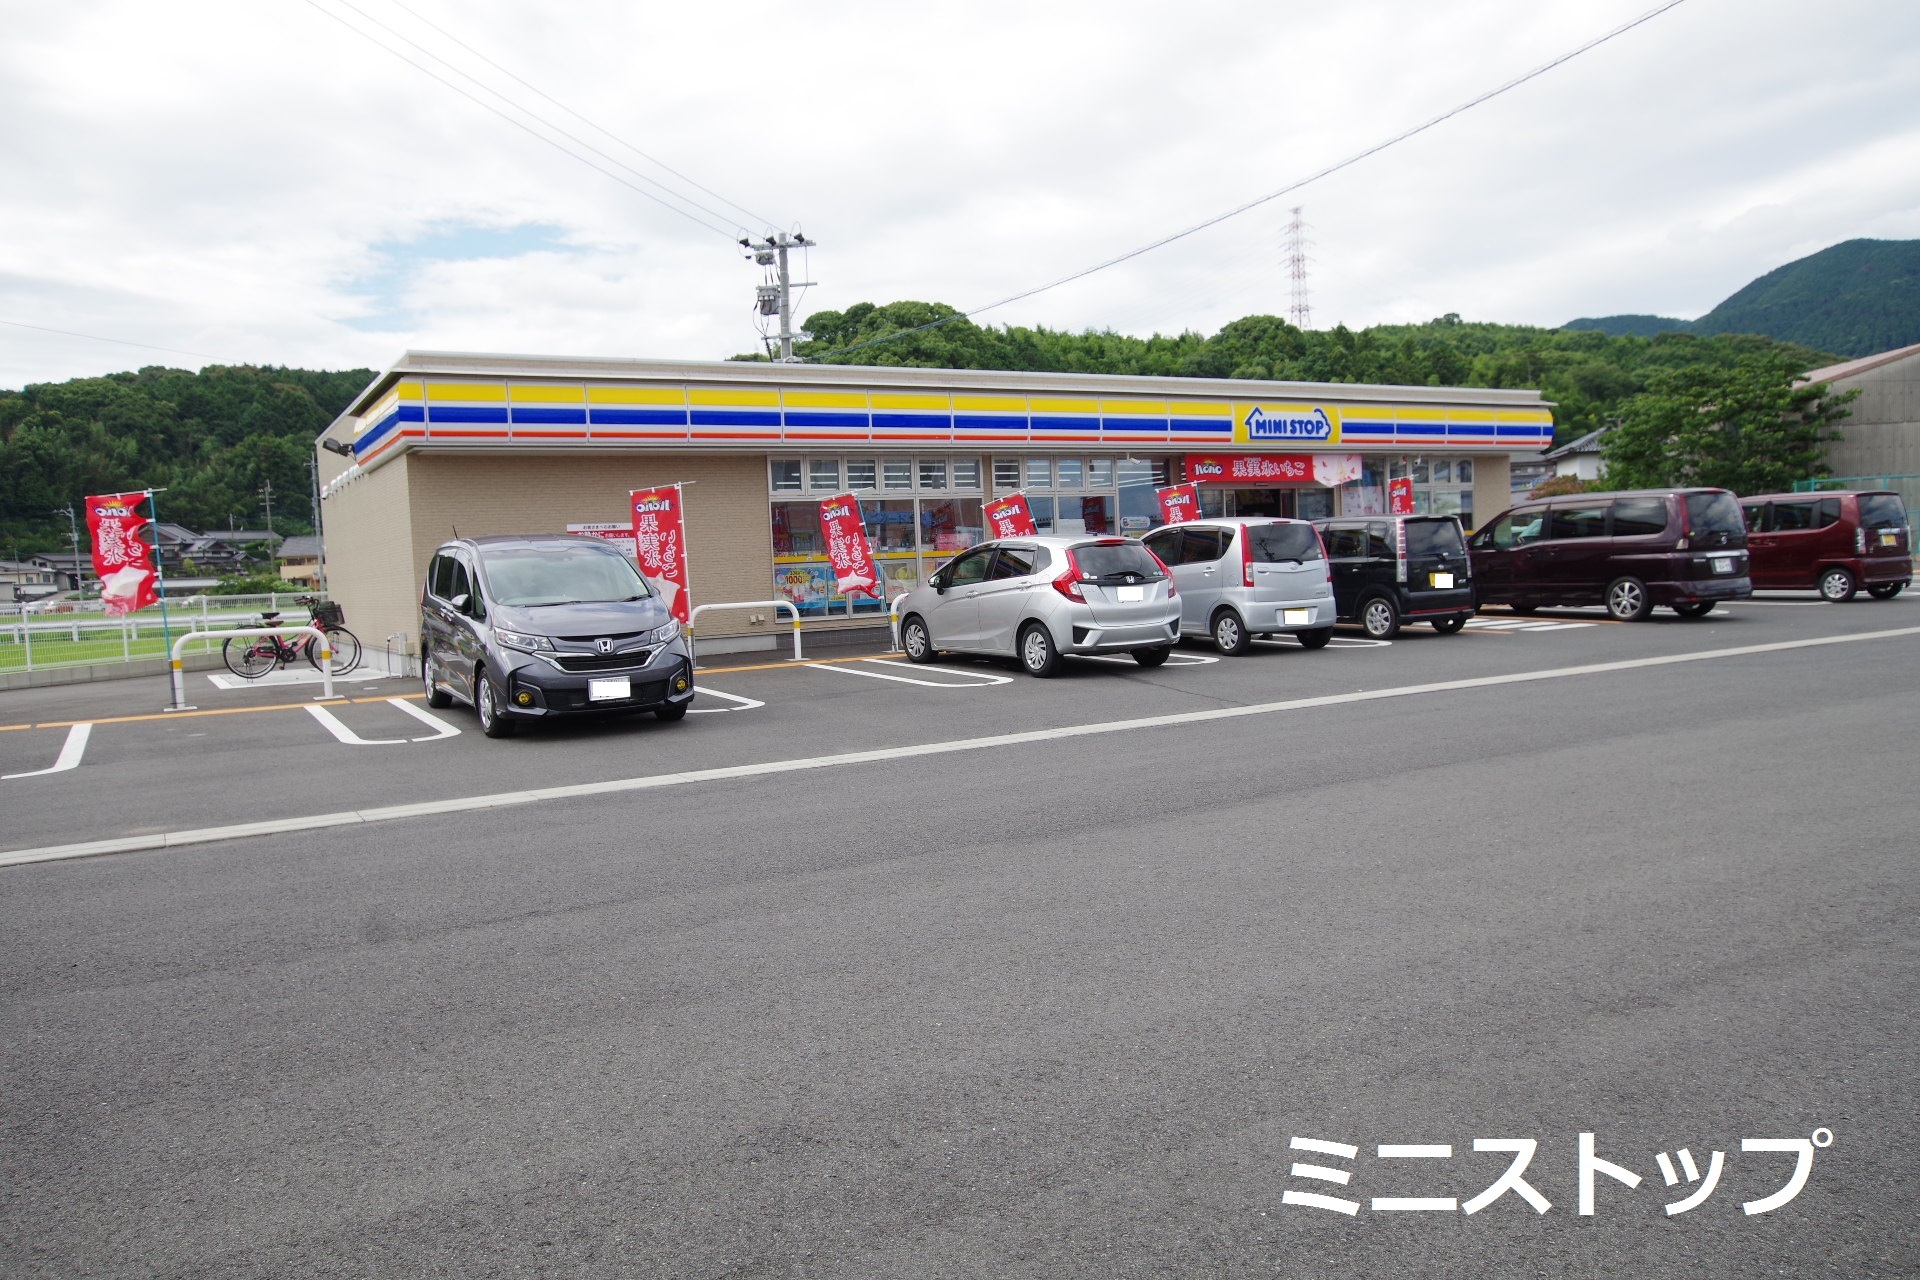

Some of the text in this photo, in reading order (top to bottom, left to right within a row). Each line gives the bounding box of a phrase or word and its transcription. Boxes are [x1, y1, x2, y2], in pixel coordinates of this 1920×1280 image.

[1256, 419, 1324, 435] MINI STOP
[1232, 460, 1305, 477] 果実氷いちご
